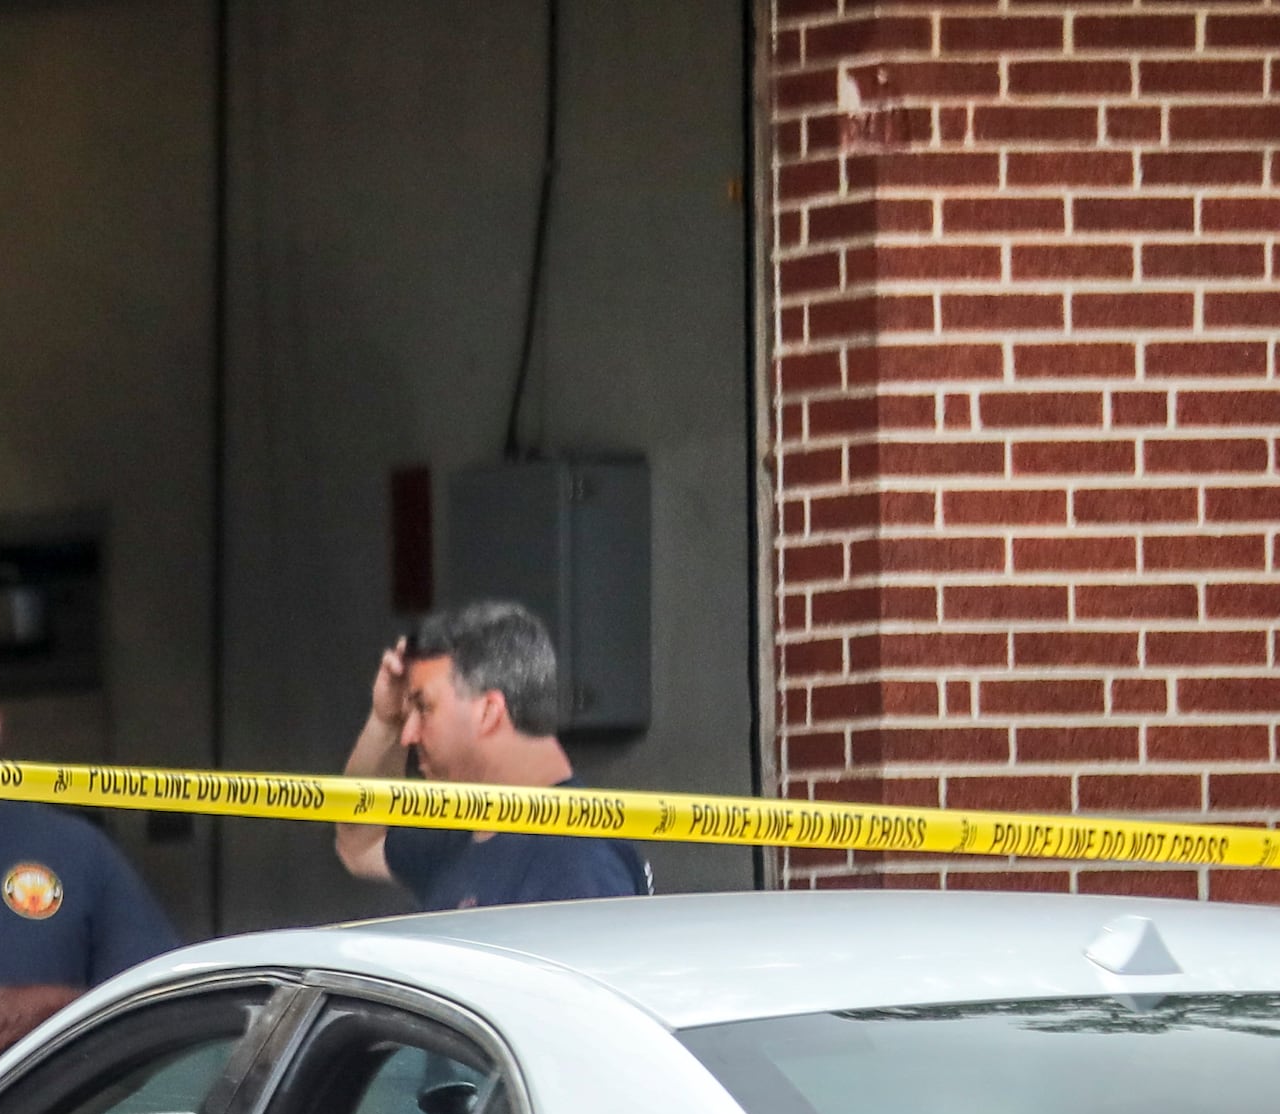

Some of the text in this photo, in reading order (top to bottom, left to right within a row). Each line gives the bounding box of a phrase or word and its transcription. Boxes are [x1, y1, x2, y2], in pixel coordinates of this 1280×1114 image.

[88, 768, 148, 797] POLICE
[154, 772, 191, 800] LINE
[197, 774, 220, 802] DO
[226, 776, 260, 805] NOT
[266, 779, 325, 809] CROSS
[388, 784, 450, 818] POLICE
[454, 789, 494, 821] LINE
[497, 792, 524, 823] DO
[526, 794, 561, 826] NOT
[567, 796, 625, 830] CROSS
[689, 803, 750, 839] POLICE
[755, 807, 794, 841] LINE
[797, 810, 825, 844] DO
[826, 812, 863, 847] NOT
[866, 814, 927, 849] CROSS
[990, 822, 1053, 857] POLICE
[1056, 826, 1097, 859] LINE
[1098, 830, 1126, 860] DO
[1128, 832, 1166, 862] NOT
[1166, 834, 1229, 864] CROSS
